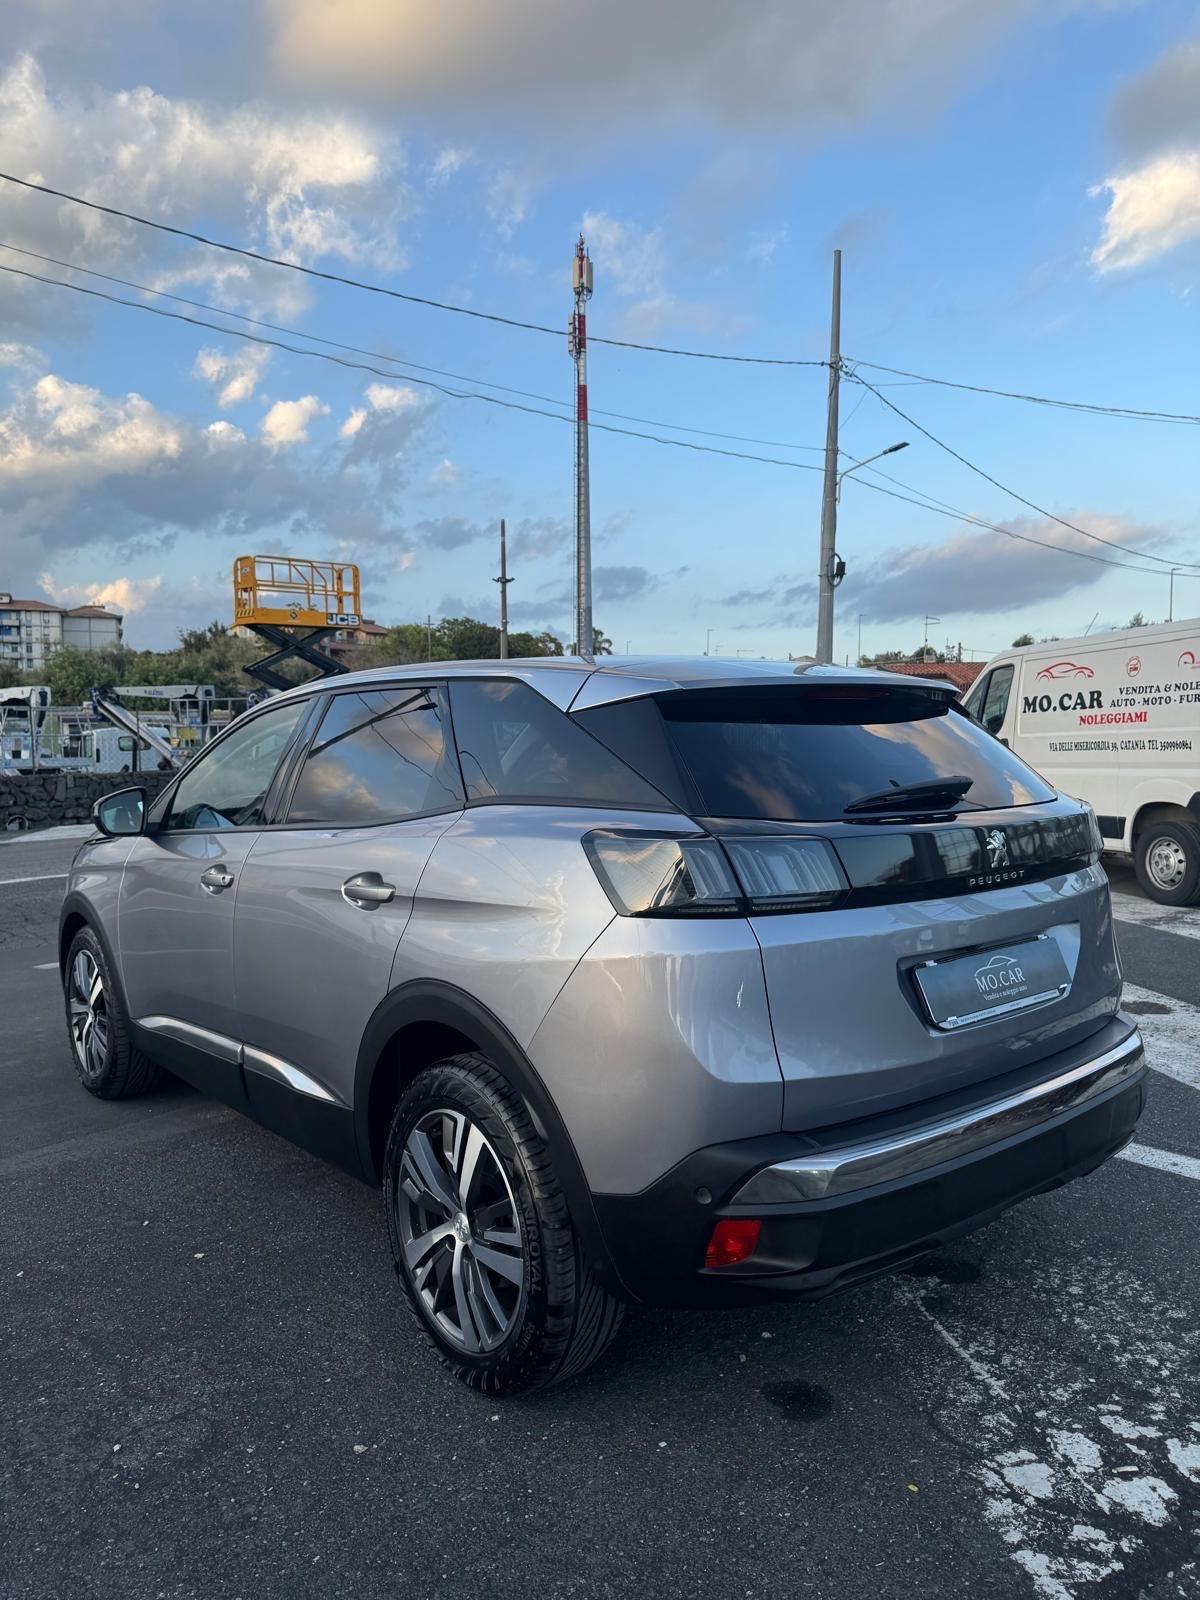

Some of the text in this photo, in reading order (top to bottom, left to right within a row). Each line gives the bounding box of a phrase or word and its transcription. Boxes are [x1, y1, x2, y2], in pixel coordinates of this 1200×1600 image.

[327, 613, 360, 626] JCB
[1118, 685, 1161, 696] VENDITA
[1164, 683, 1173, 693] &
[1022, 690, 1103, 713] MO.CAR
[1110, 698, 1136, 708] AUTO
[1142, 696, 1172, 706] MOTO
[1079, 711, 1148, 725] NOLEGGIAMI
[1049, 742, 1058, 752] VIA
[1058, 741, 1073, 752] DELLE
[1074, 740, 1111, 751] MISERICORDIA
[1120, 739, 1146, 751] CATANIA
[1148, 739, 1159, 750] TEL
[969, 869, 1025, 888] PEUGEOT
[975, 967, 1026, 993] MO.CAR
